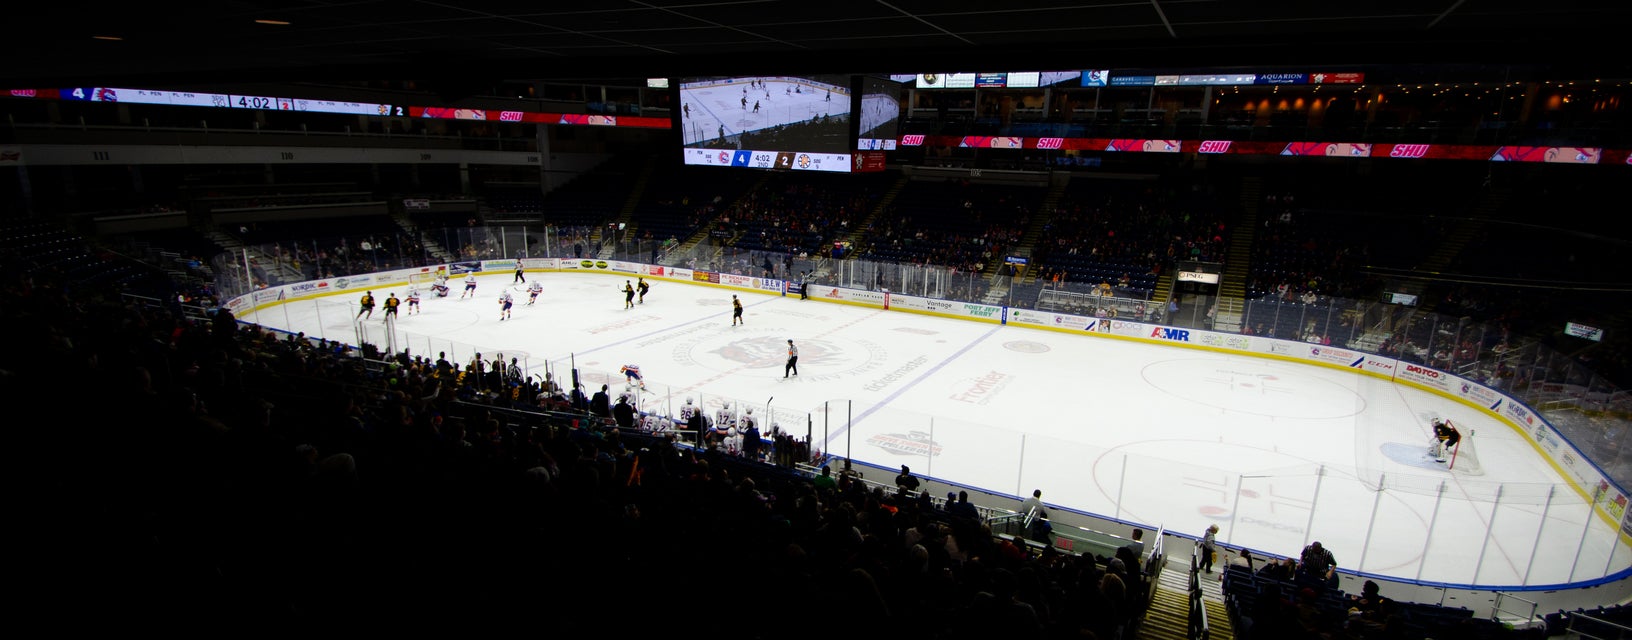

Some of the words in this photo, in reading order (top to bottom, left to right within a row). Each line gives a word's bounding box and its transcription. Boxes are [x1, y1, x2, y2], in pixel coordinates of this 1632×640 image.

[72, 87, 85, 99] 4
[238, 96, 270, 110] 4:02
[282, 102, 289, 110] 2
[396, 106, 405, 116] 2
[499, 111, 524, 122] SHU
[901, 135, 926, 146] SHU
[1036, 138, 1064, 150] SHU
[1198, 141, 1231, 154] SHU
[1390, 144, 1429, 158] SHU
[738, 153, 745, 163] 4
[782, 156, 789, 166] 2
[291, 283, 317, 291] NORDIC
[926, 300, 952, 309] Vantage
[969, 309, 993, 317] FERRY
[1151, 327, 1190, 342] AMR
[1367, 360, 1393, 370] CCM
[862, 354, 929, 392] ticketmaster
[949, 370, 1007, 404] Frontier
[681, 409, 692, 421] 26
[719, 415, 733, 425] 17
